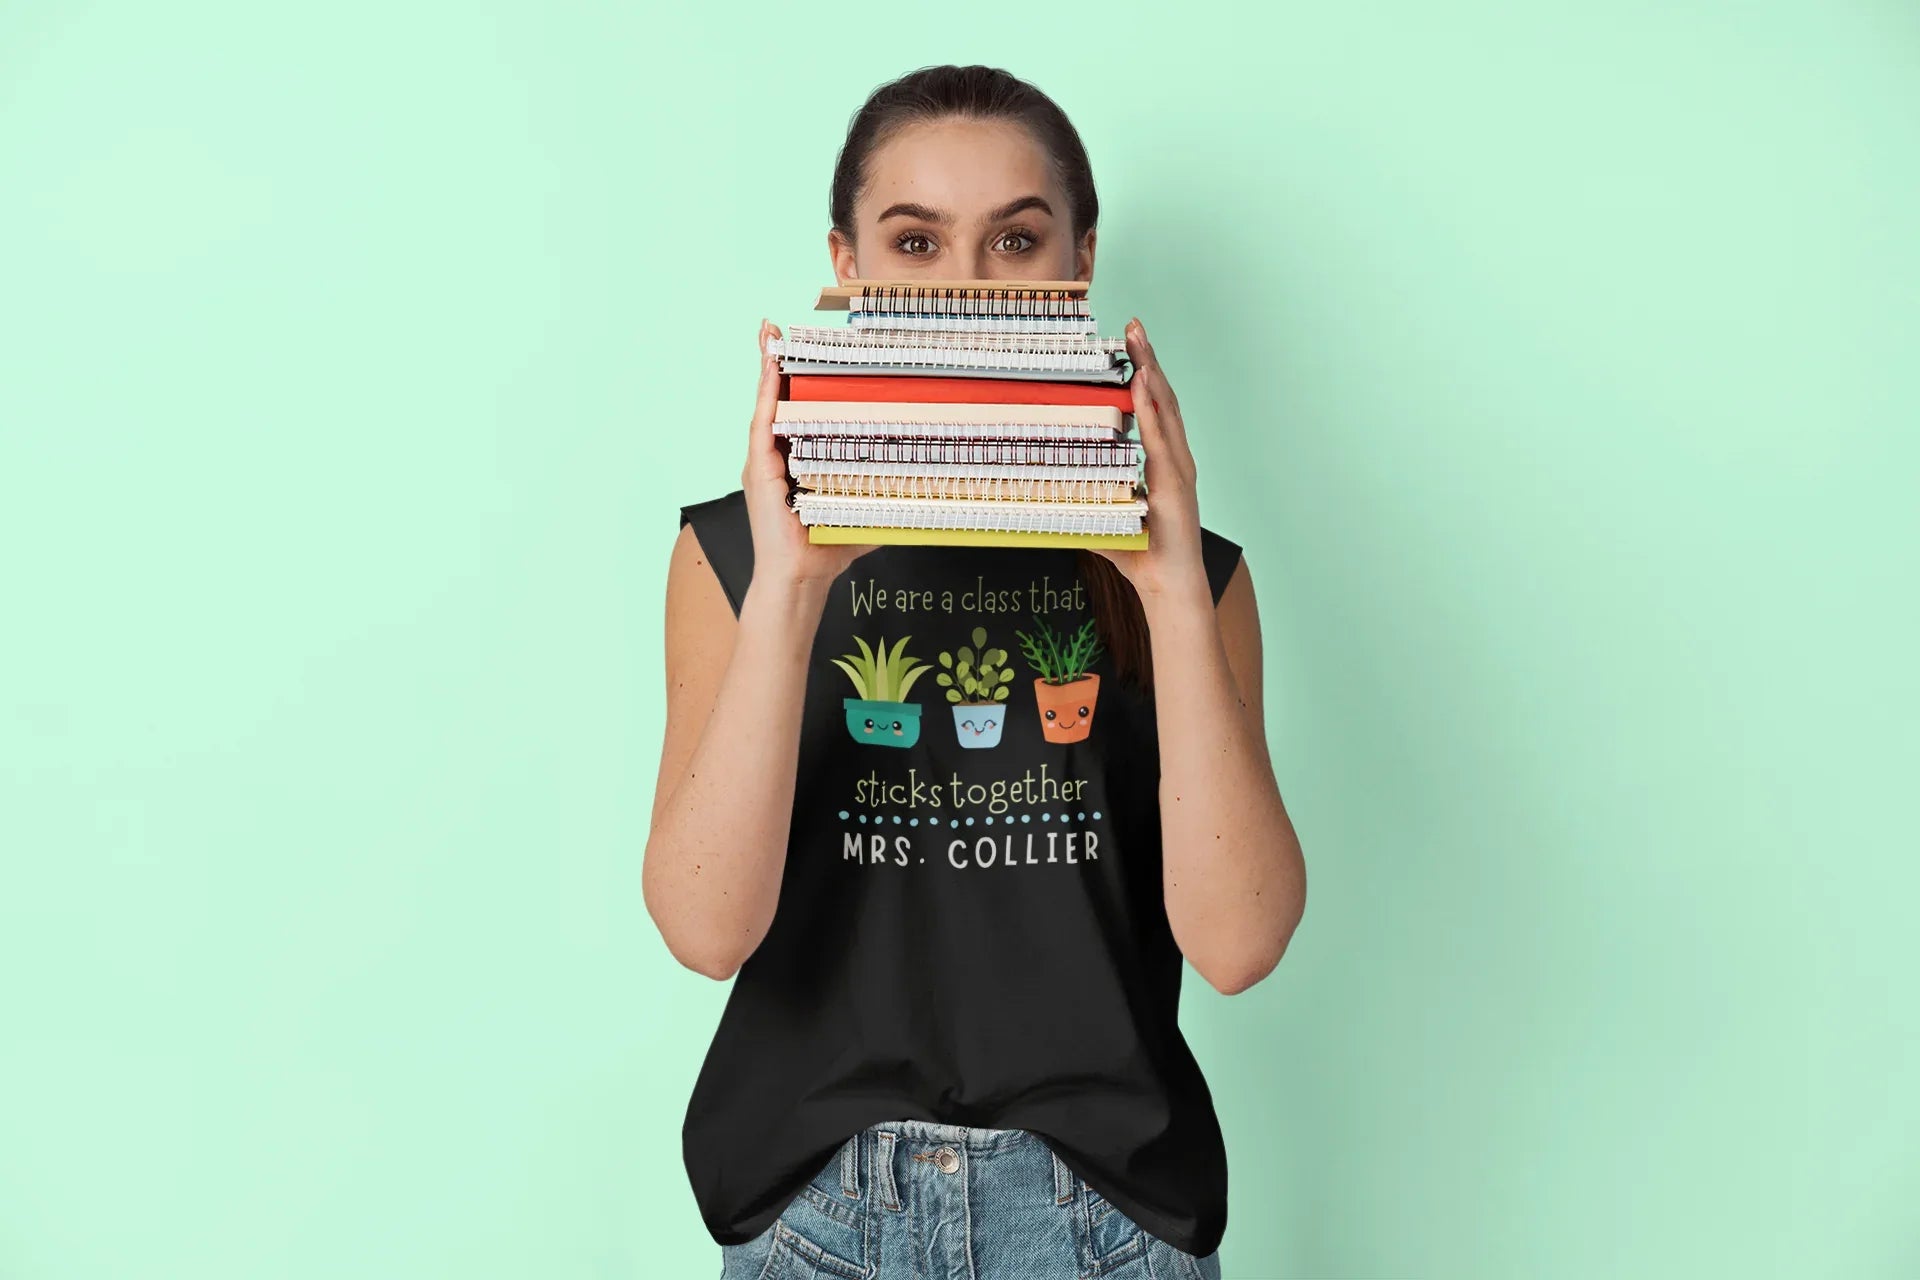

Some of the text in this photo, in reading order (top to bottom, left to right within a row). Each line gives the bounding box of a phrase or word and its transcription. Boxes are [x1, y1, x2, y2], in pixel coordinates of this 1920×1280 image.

[850, 576, 1086, 617] We are a class that
[855, 764, 1088, 814] sticks together
[843, 831, 1099, 869] MRS. COLLIER
